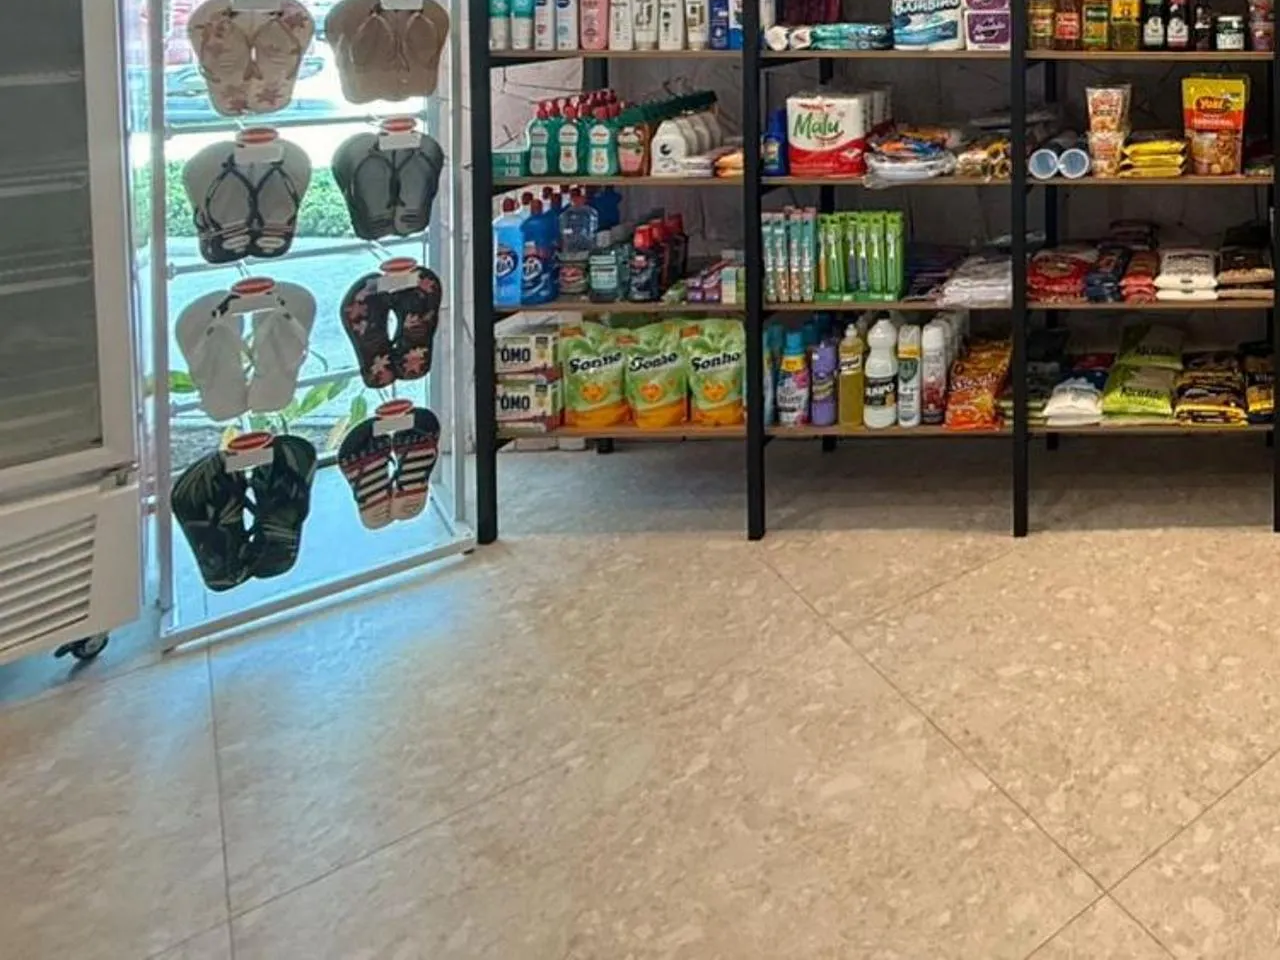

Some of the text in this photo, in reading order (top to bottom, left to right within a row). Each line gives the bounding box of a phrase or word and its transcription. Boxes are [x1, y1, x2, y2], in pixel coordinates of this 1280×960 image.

[793, 112, 840, 141] Malu
[501, 347, 531, 363] OMO
[501, 394, 530, 410] OMO
